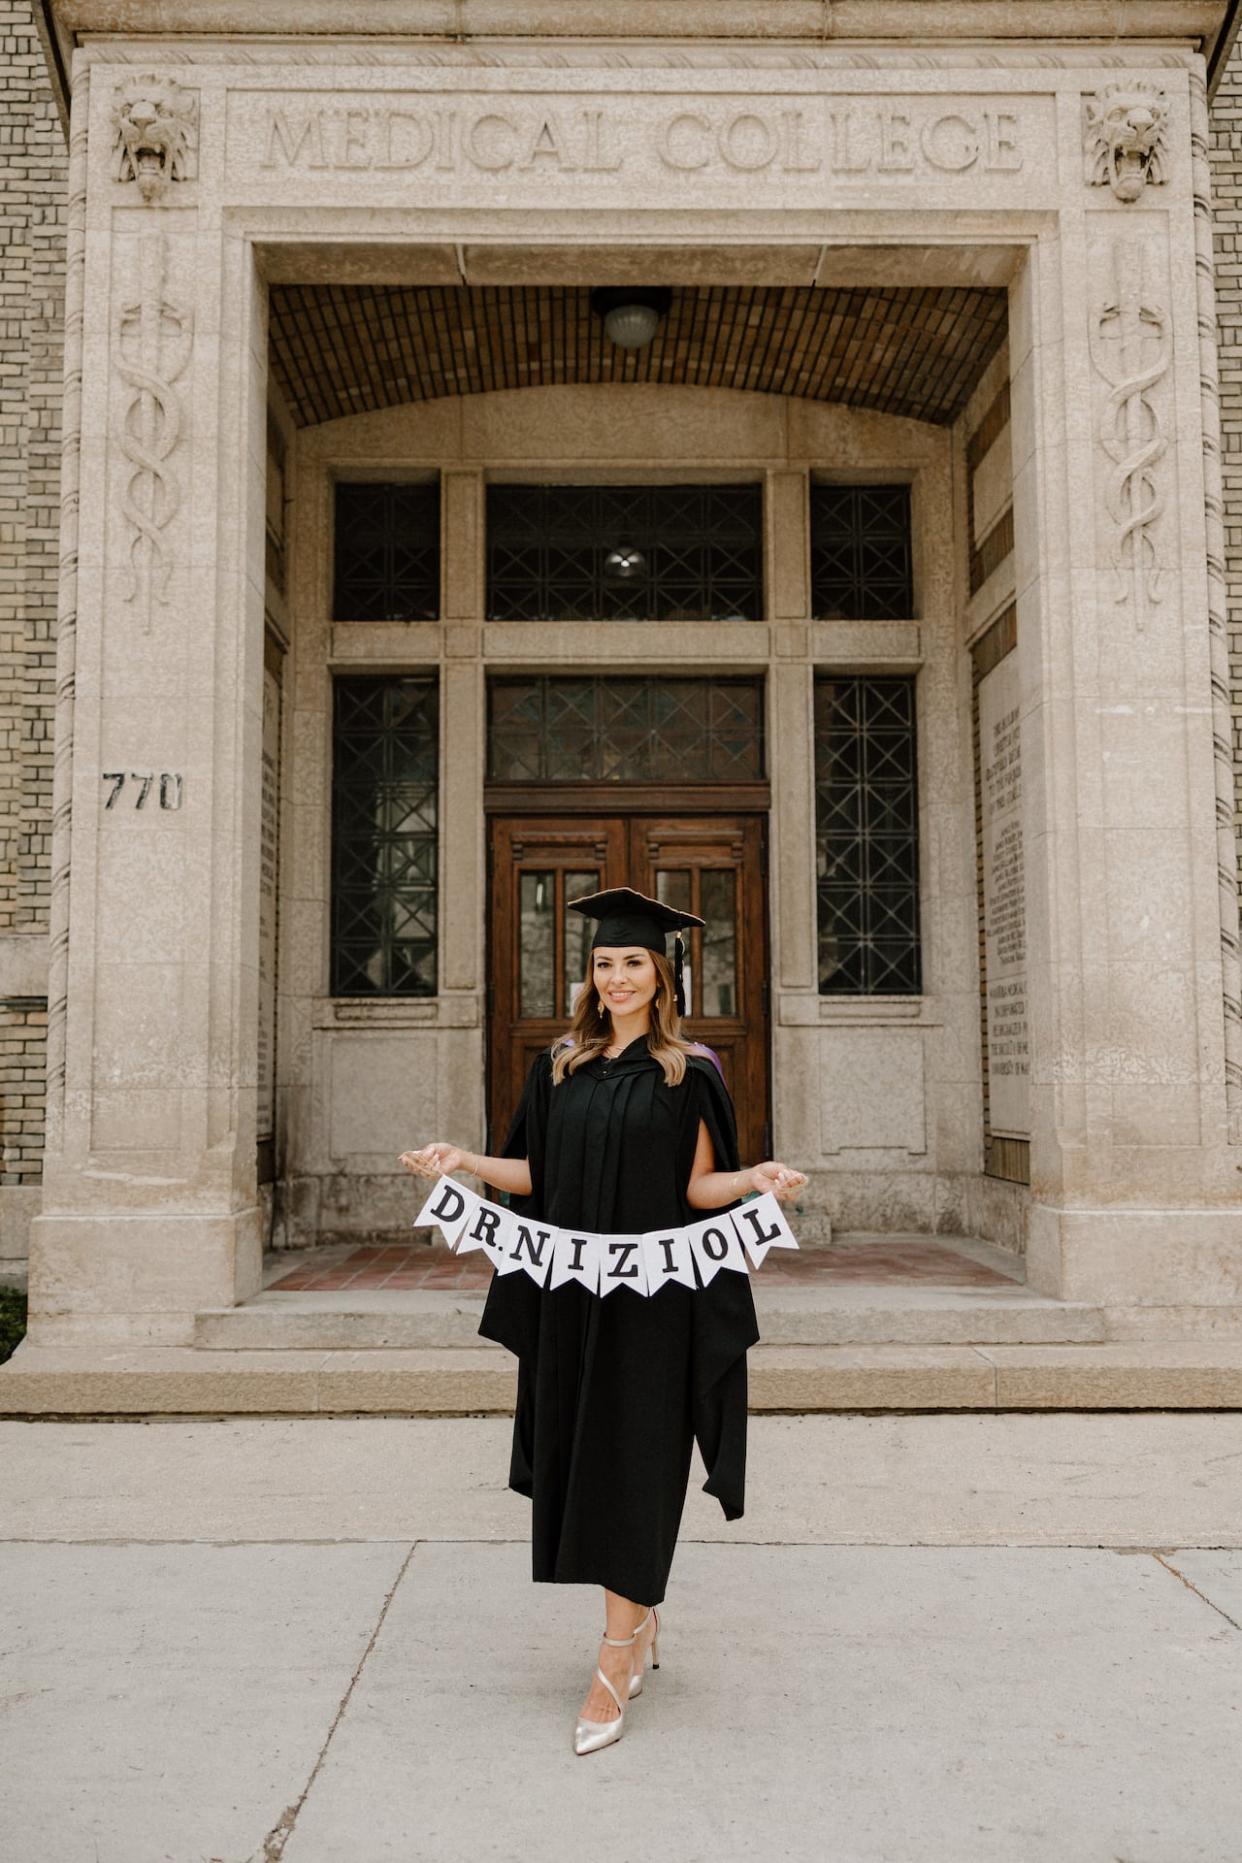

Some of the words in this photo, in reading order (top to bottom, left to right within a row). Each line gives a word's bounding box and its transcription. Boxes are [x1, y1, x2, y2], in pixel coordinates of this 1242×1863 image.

[260, 108, 624, 172] MEDICAL
[655, 111, 1024, 175] COLLEGE
[103, 773, 183, 811] 770
